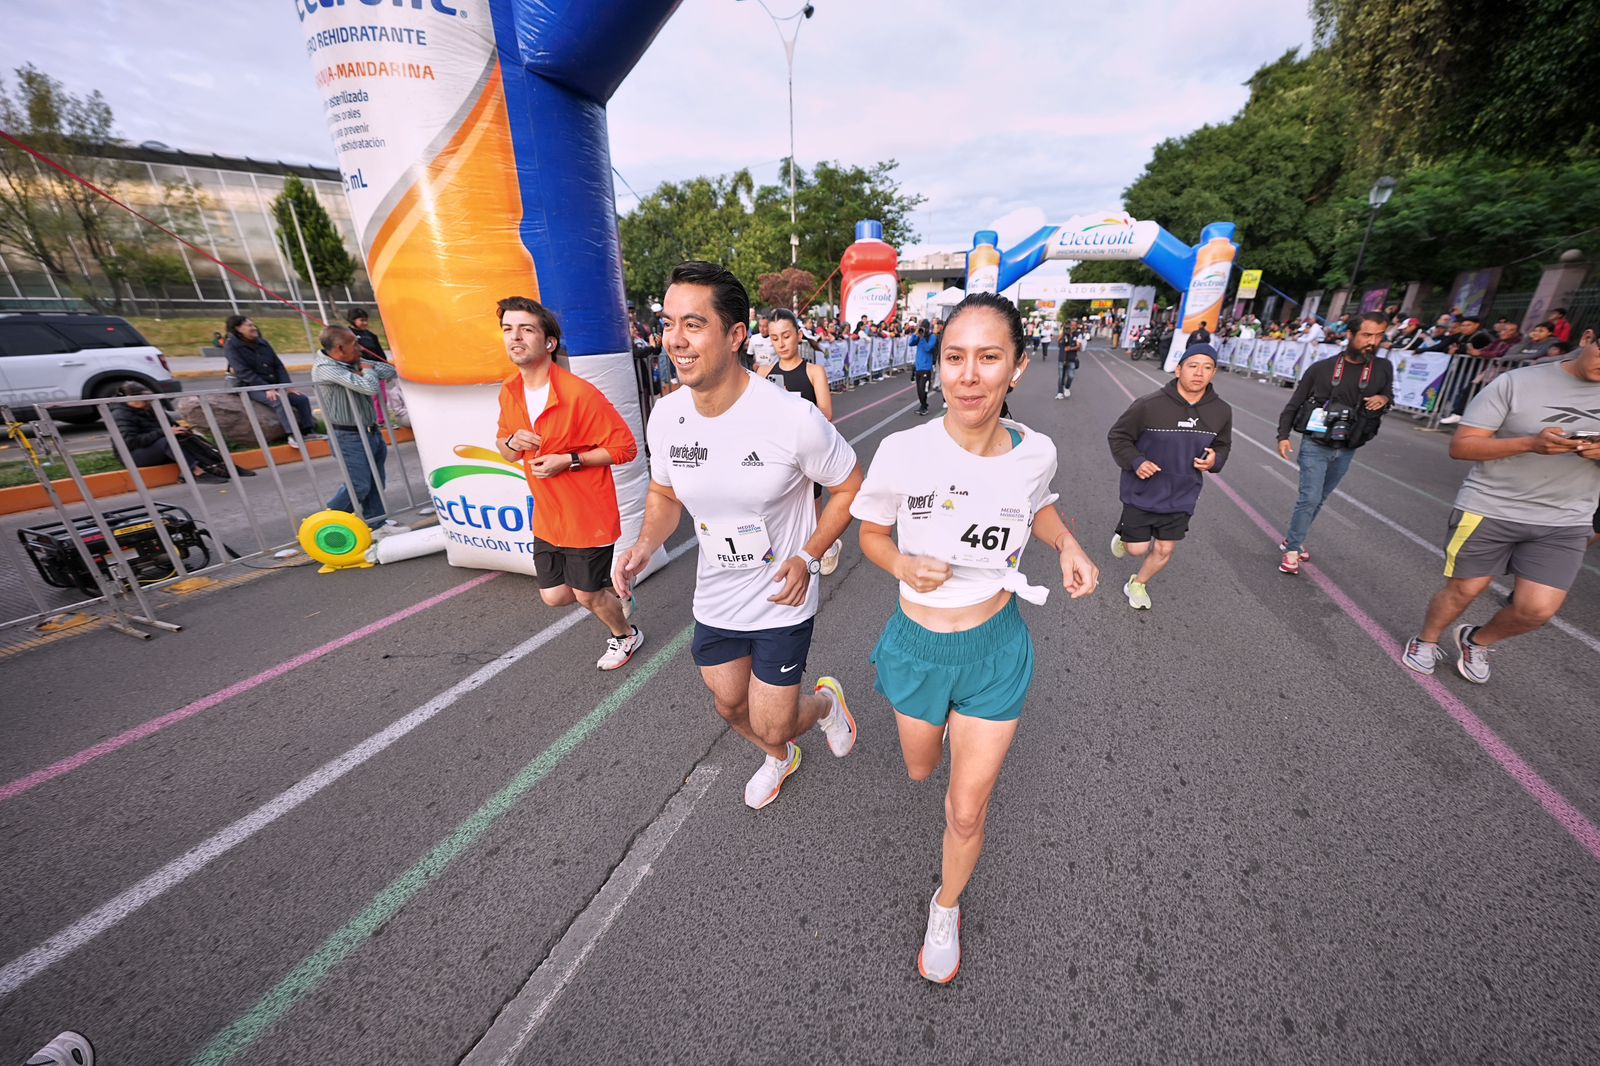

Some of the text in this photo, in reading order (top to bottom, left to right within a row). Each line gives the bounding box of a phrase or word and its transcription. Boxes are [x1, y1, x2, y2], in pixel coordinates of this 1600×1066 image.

[317, 26, 427, 46] REHIDRATANTE
[351, 168, 368, 190] mL
[1059, 230, 1135, 246] Electrolit
[725, 537, 736, 554] 1
[960, 524, 1011, 551] 461
[717, 553, 755, 563] FELIFER
